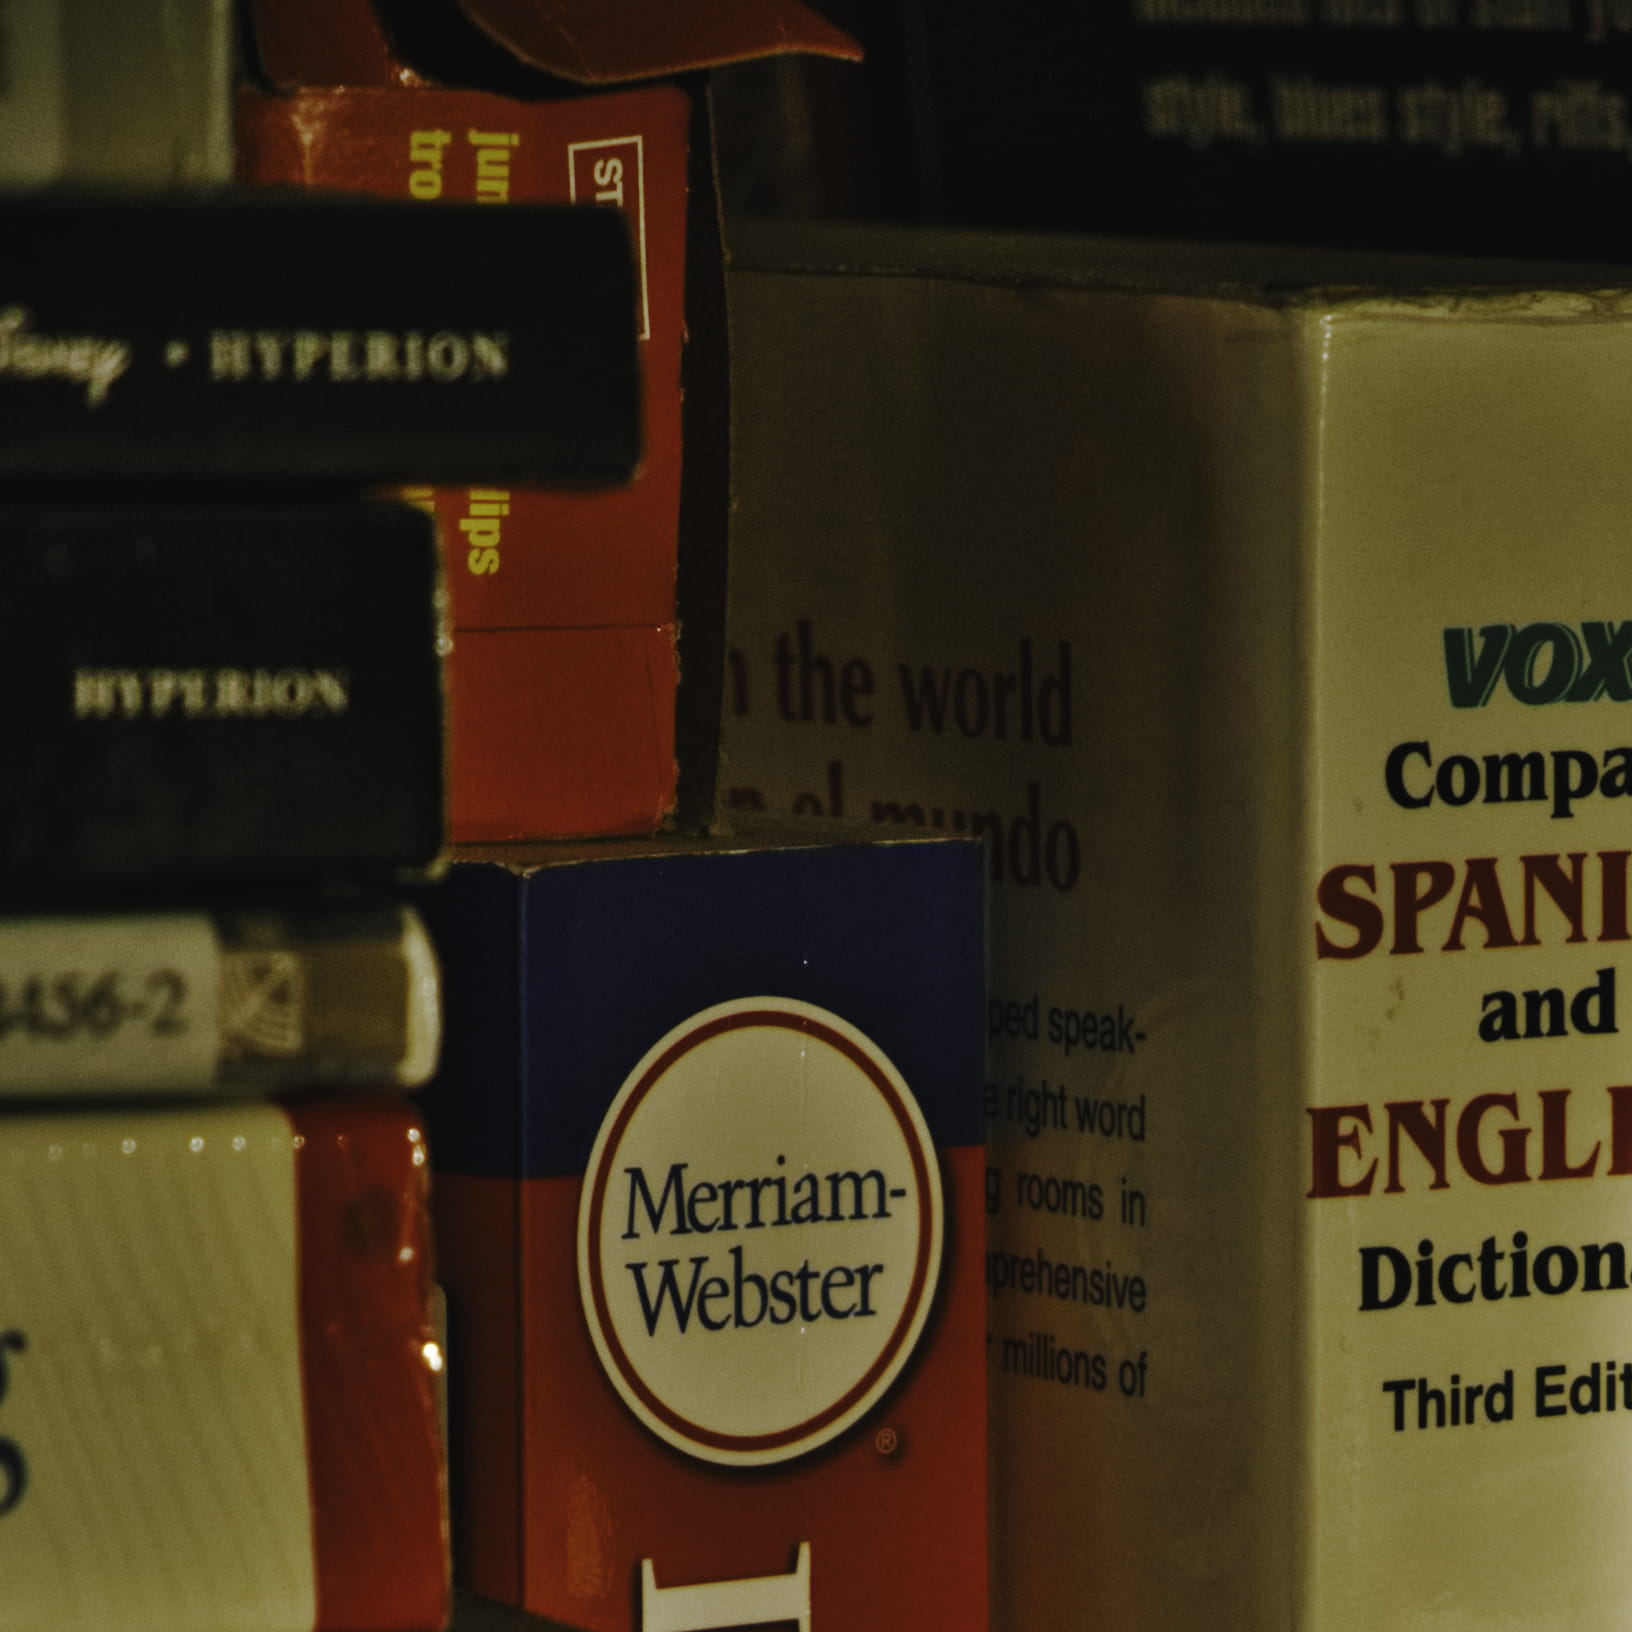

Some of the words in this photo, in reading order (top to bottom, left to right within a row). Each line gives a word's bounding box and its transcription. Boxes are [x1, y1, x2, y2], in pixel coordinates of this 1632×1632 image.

[208, 328, 510, 383] HYPERION
[777, 620, 874, 728] the
[899, 638, 1072, 747] world
[1048, 1005, 1146, 1056] speak-
[1477, 967, 1619, 1043] and
[1007, 1077, 1067, 1138] right
[1075, 1095, 1146, 1142] word
[621, 1155, 907, 1239] Merriam-
[1017, 1171, 1102, 1220] rooms
[1121, 1177, 1146, 1227] in
[626, 1246, 884, 1337] Webster
[1003, 1331, 1107, 1391] millions
[1119, 1350, 1147, 1399] of
[1383, 1370, 1514, 1432] Third
